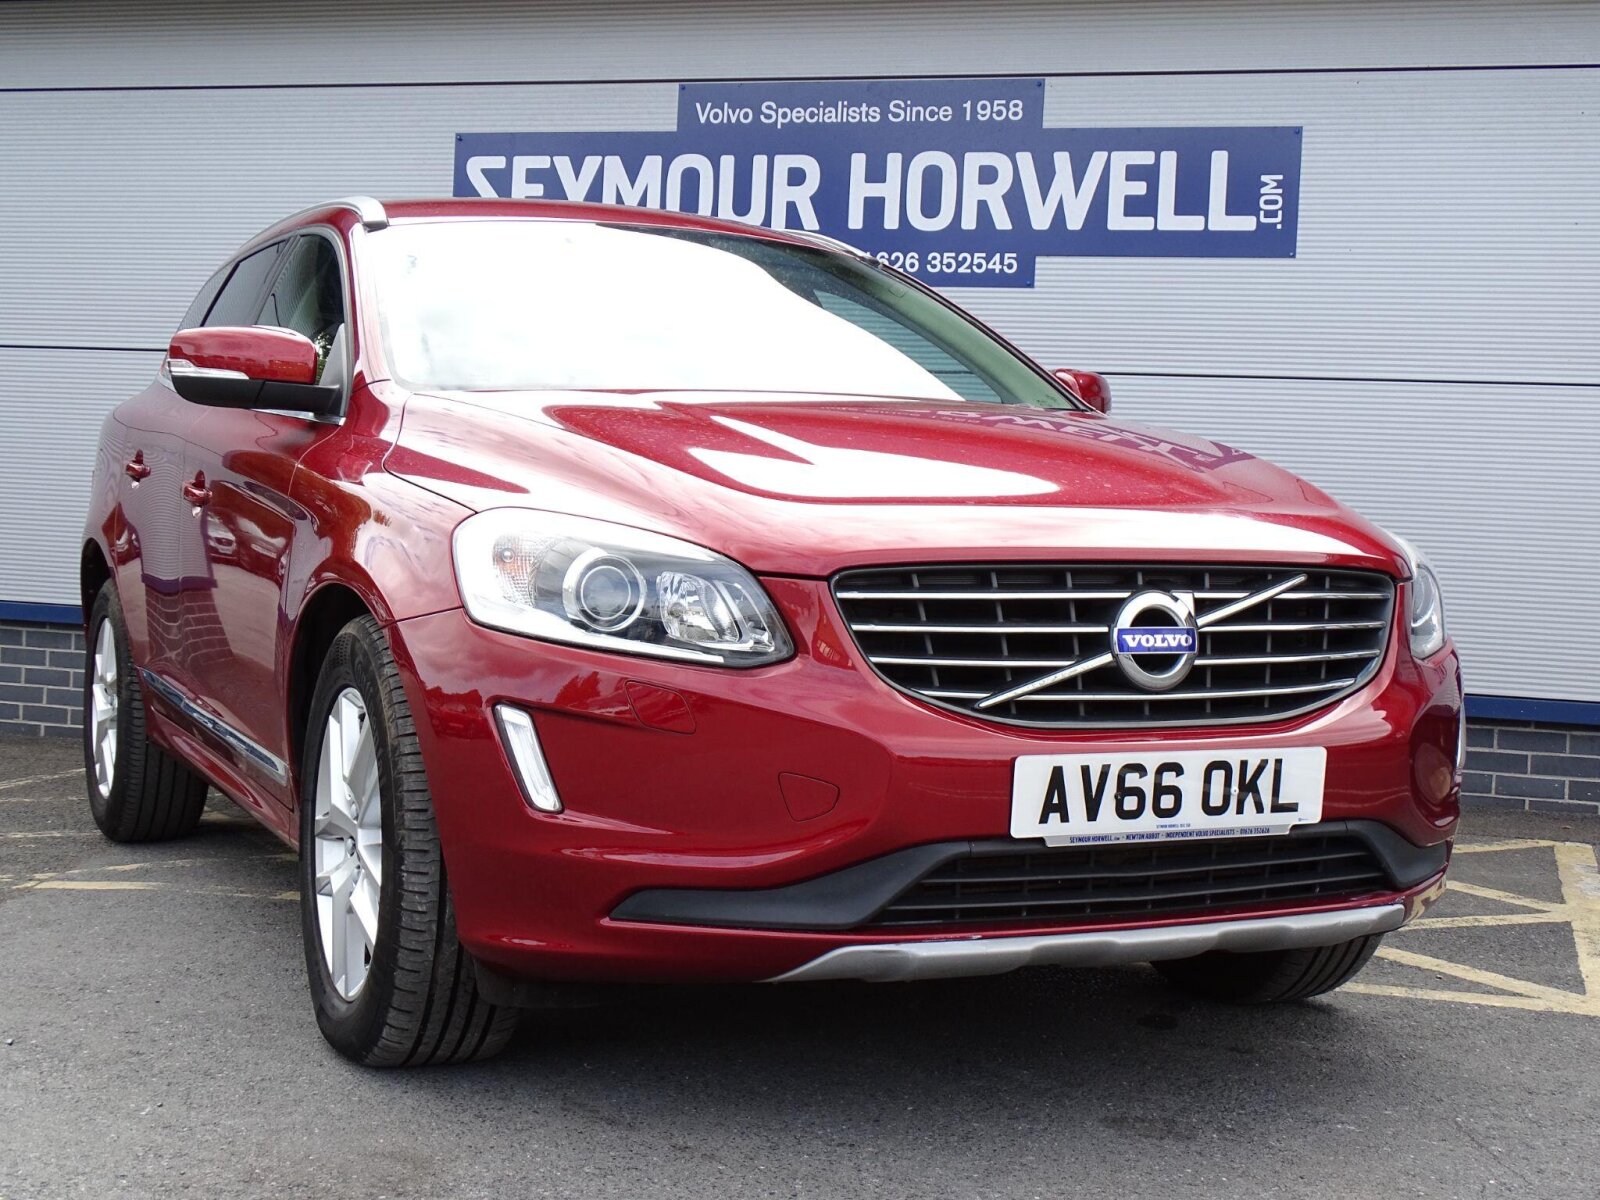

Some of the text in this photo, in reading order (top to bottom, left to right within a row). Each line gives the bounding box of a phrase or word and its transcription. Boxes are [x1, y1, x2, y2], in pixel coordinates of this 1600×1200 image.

[695, 100, 1024, 129] Volvo Specialists Since 1958
[848, 150, 1257, 231] HORWELL
[1259, 174, 1284, 230] .COM
[926, 252, 1018, 273] 352545
[1122, 634, 1193, 648] VOLVO
[1038, 758, 1300, 825] AV66 OKL
